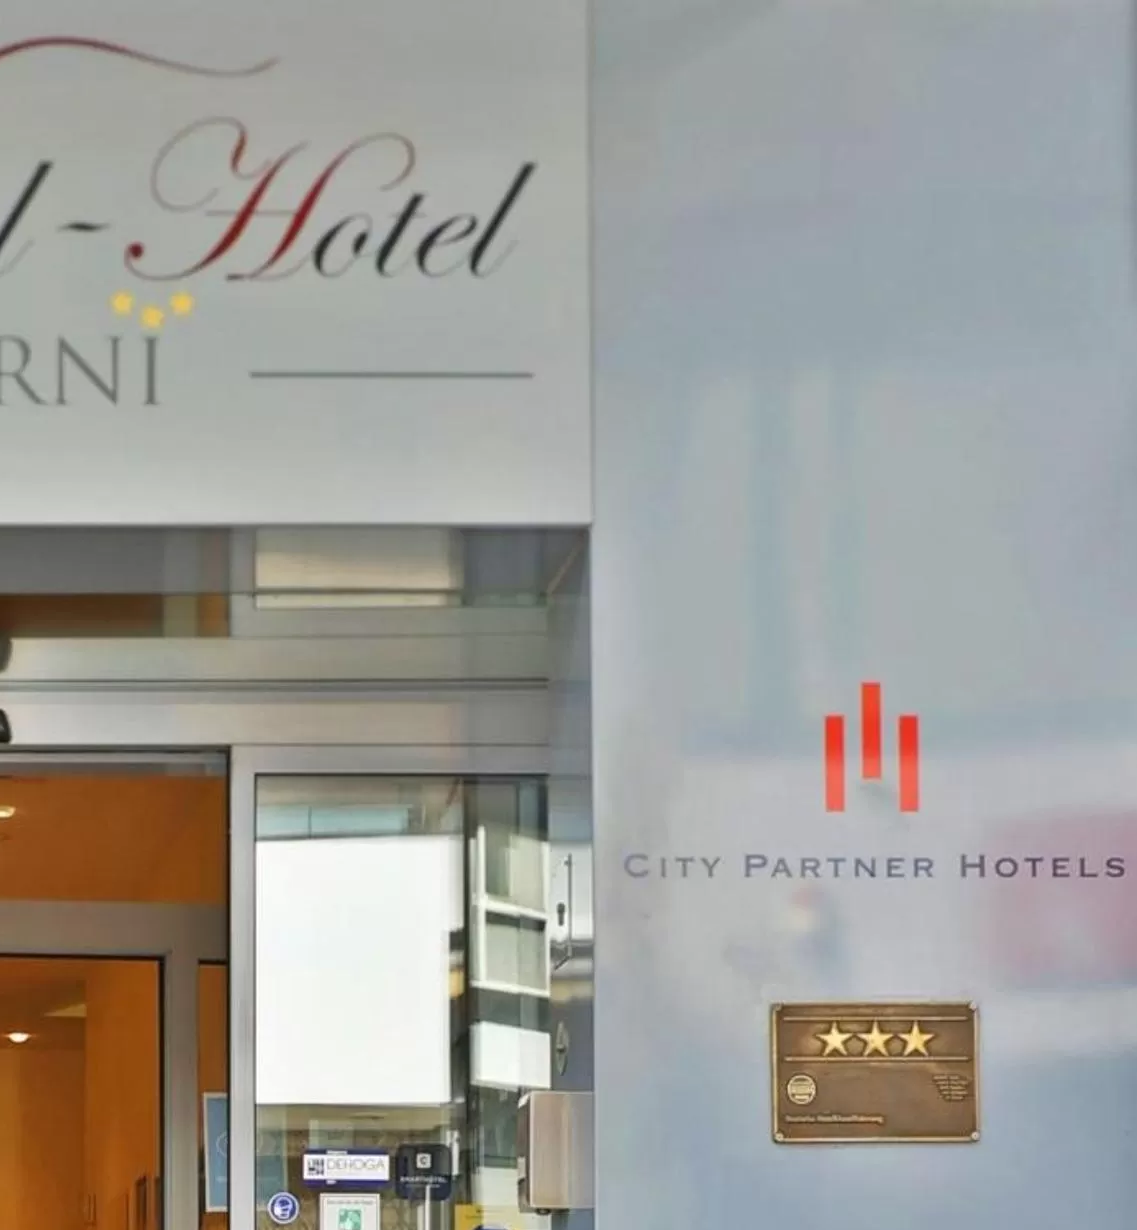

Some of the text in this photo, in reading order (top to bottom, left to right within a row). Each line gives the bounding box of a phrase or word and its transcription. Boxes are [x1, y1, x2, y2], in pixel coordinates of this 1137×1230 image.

[123, 115, 538, 282] Hotel
[623, 853, 1126, 879] CITY PARTNER HOTELS
